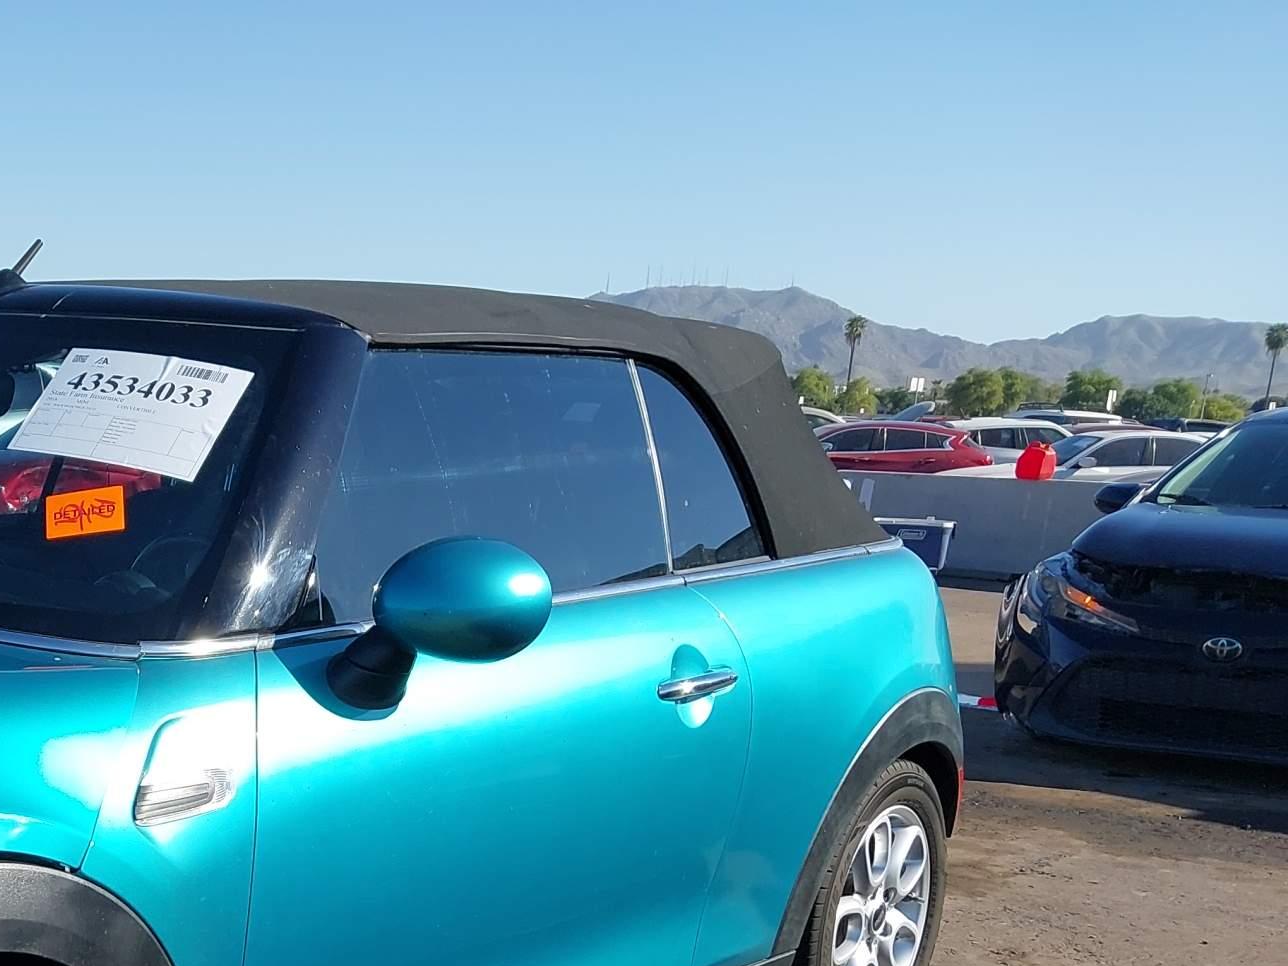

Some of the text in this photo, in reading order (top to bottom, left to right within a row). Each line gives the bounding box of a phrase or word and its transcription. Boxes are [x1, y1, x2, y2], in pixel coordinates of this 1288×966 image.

[49, 389, 126, 404] State Farm Insurance
[67, 371, 213, 408] 43534033
